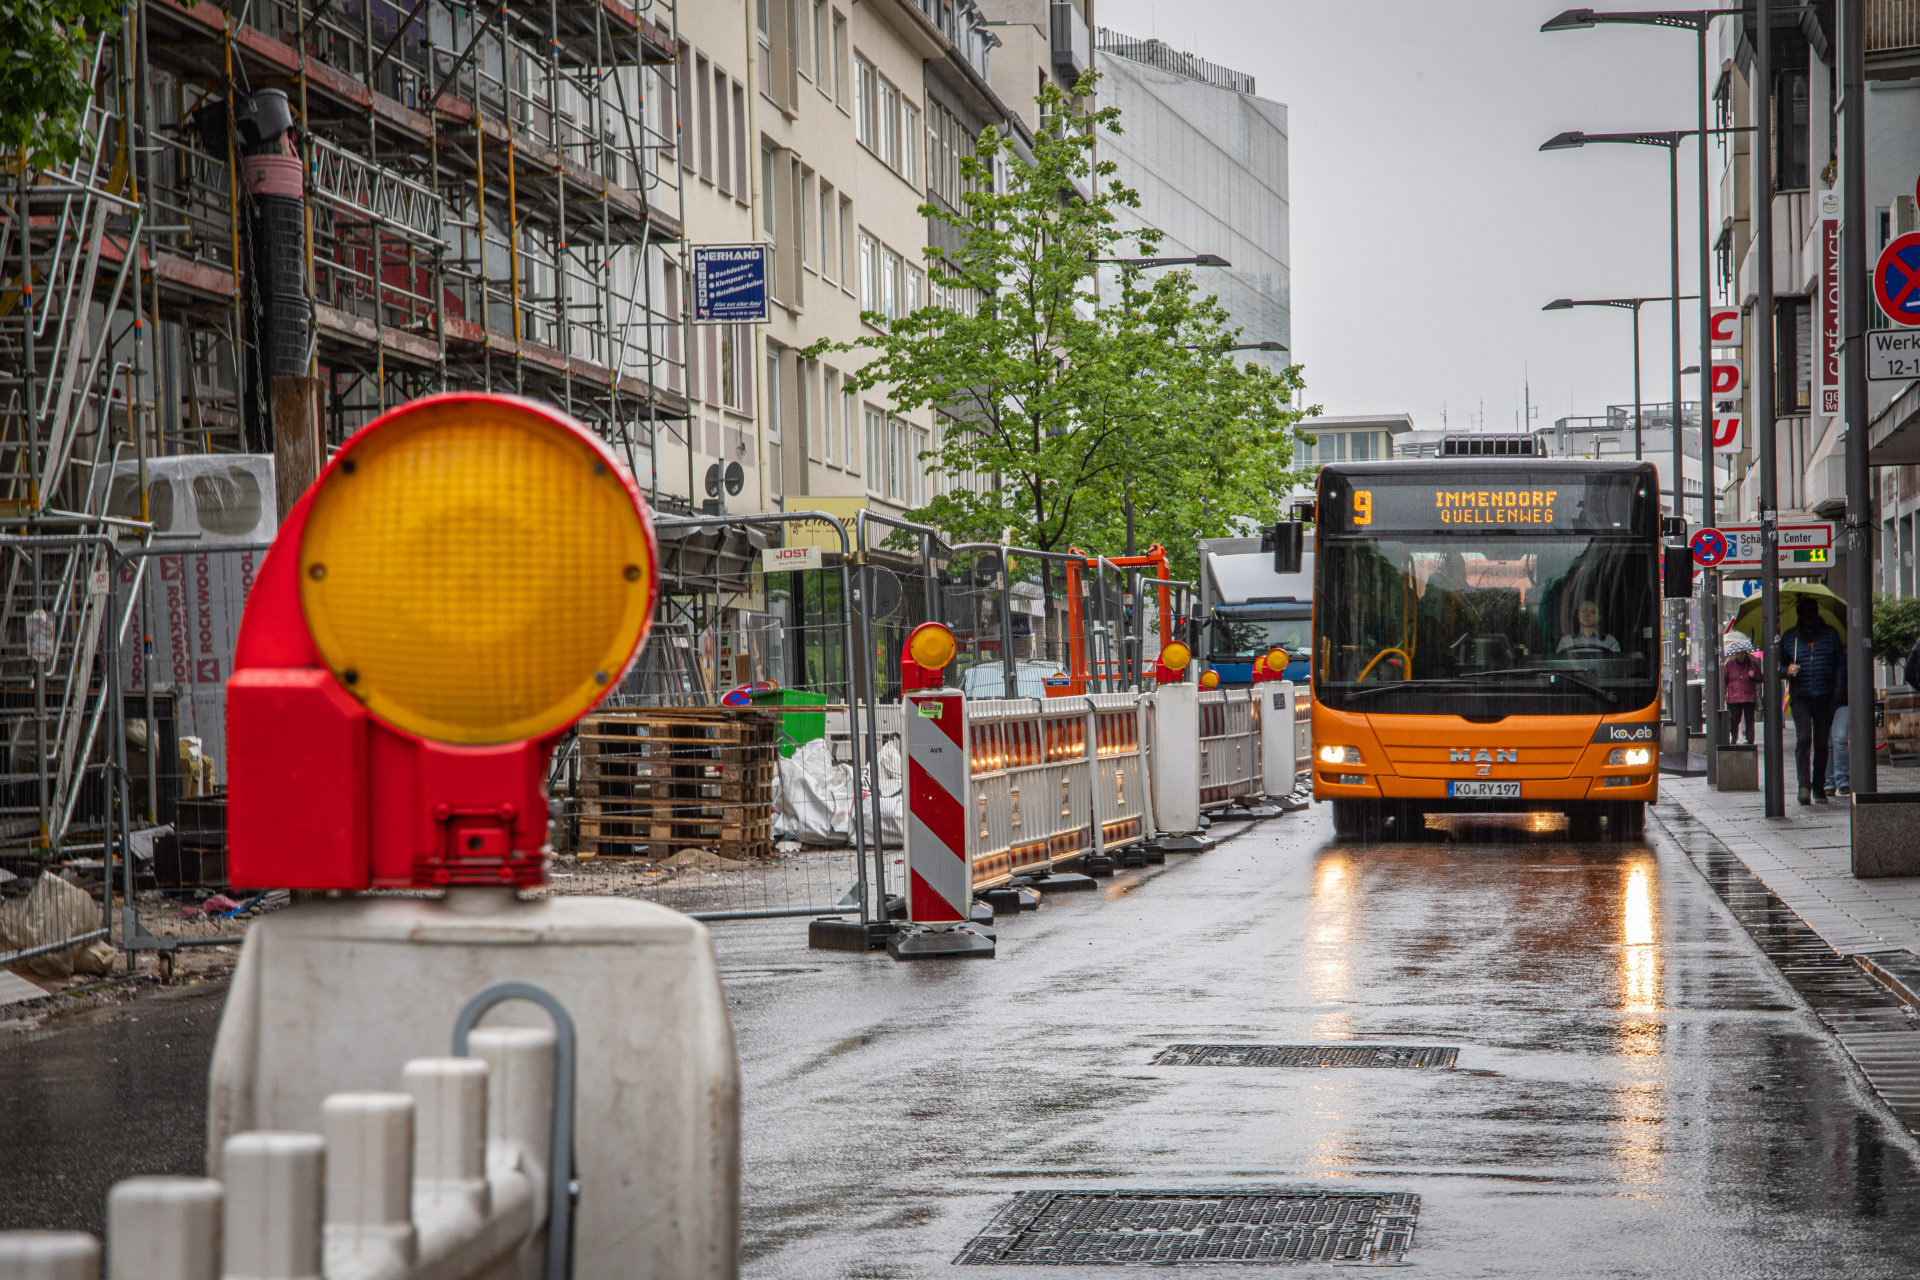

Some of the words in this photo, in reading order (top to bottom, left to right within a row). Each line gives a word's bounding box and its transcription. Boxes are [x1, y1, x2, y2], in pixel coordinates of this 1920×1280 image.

[697, 250, 760, 261] WERHAND
[1711, 312, 1740, 447] CDU
[1353, 490, 1372, 525] 9
[1436, 491, 1557, 507] IMMENDORF
[1440, 509, 1553, 523] QUELLENWEG
[1740, 533, 1761, 544] Schä
[1784, 533, 1812, 543] Center
[776, 549, 808, 559] JOST
[1809, 549, 1826, 562] 11
[196, 552, 212, 653] ROCKWOOL
[167, 586, 187, 689] ROCKWOOL
[1450, 749, 1517, 762] MAN
